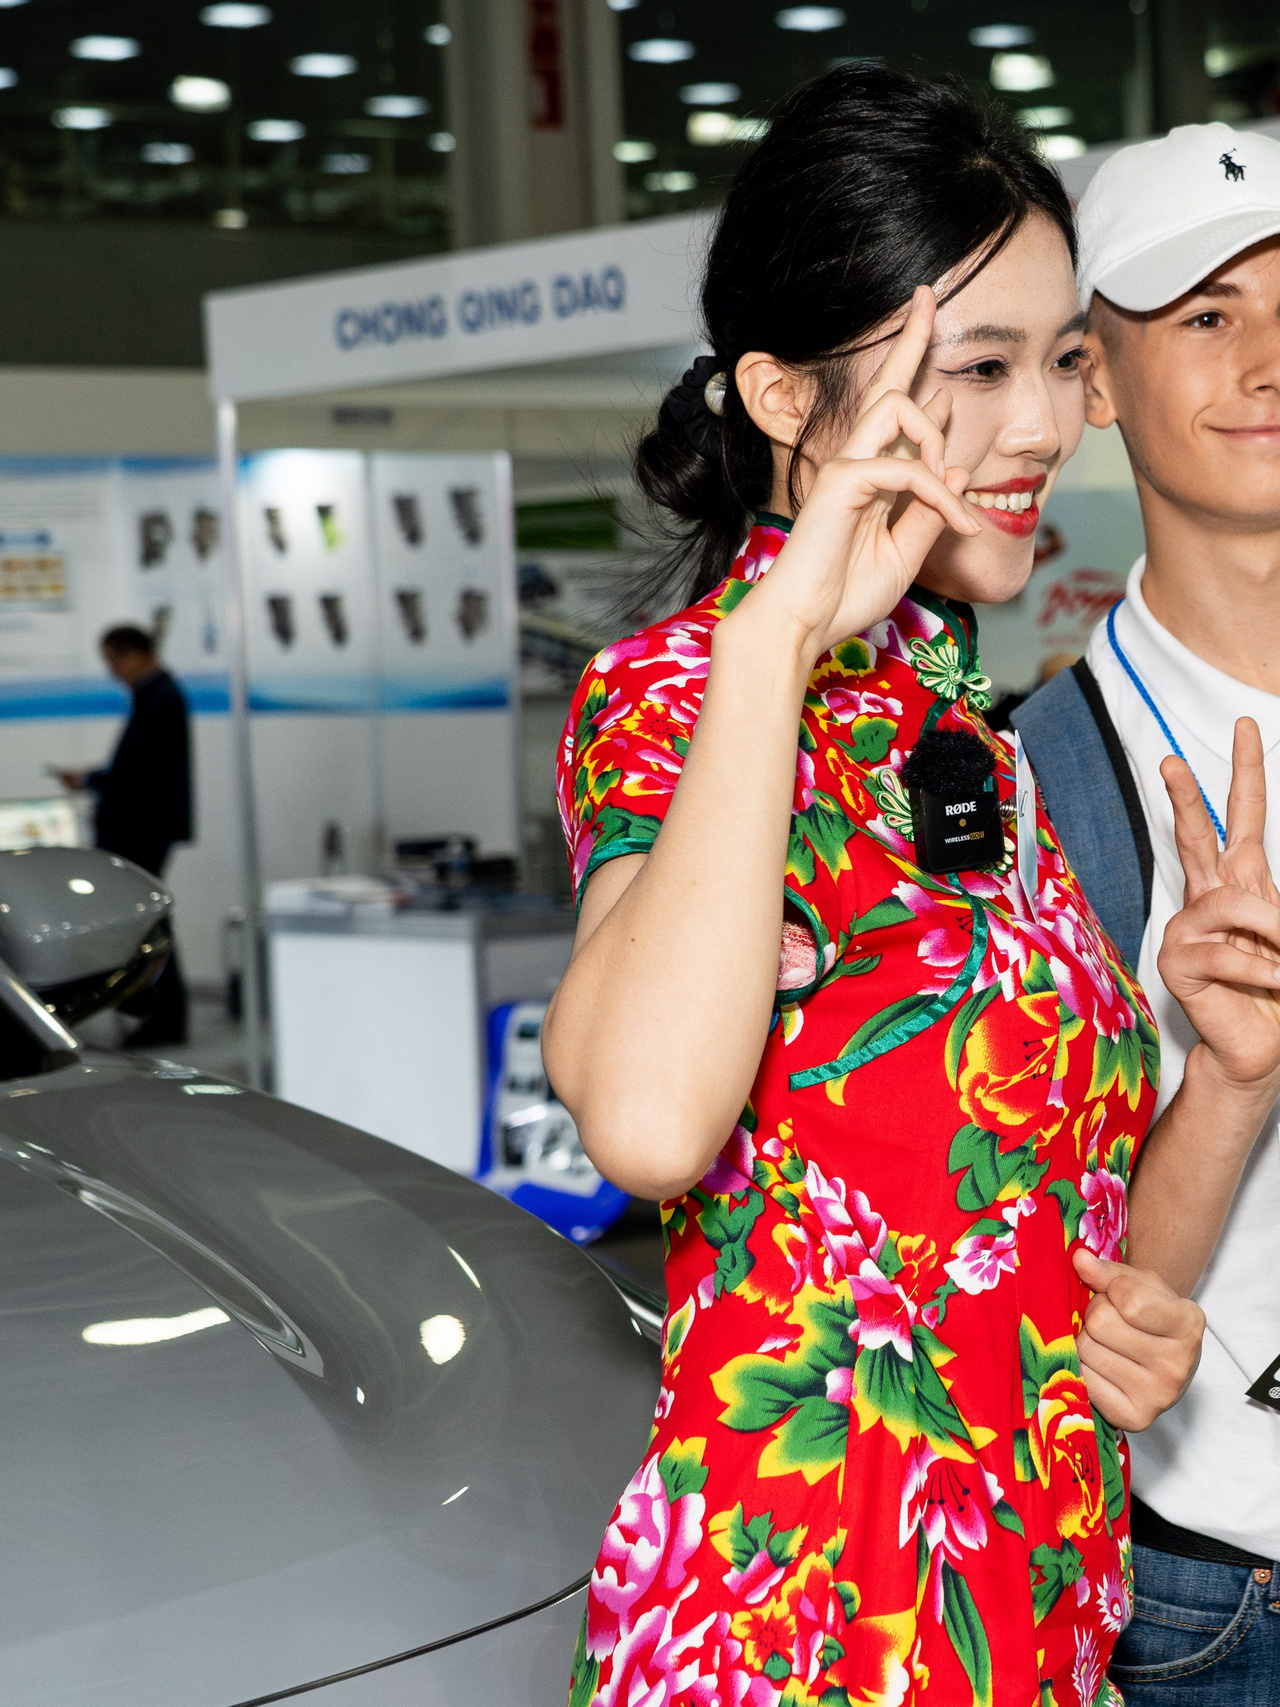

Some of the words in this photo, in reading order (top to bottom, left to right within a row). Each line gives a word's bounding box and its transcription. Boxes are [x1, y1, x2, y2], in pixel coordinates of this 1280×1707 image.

[336, 294, 446, 350] CHONG
[459, 279, 541, 334] QING
[945, 801, 977, 816] RØDE
